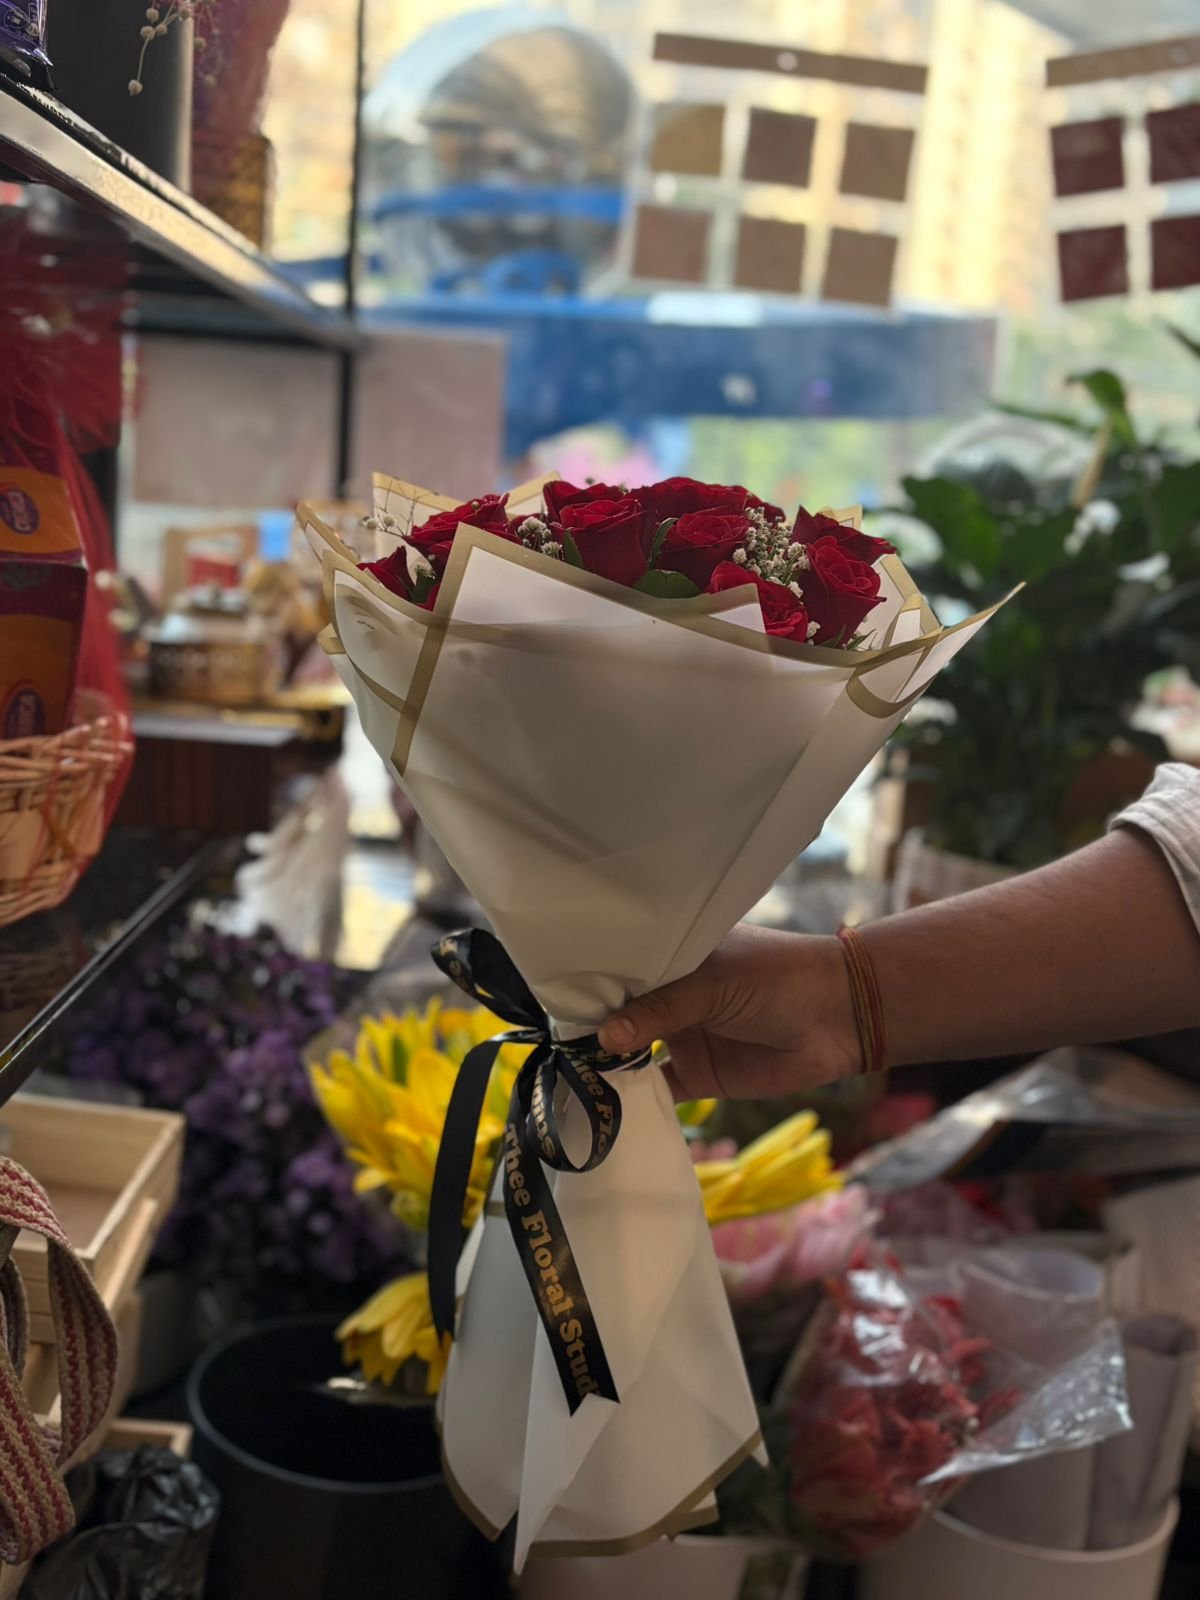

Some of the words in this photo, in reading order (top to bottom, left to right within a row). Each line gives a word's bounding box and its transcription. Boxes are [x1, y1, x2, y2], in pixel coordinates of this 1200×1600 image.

[504, 1123, 532, 1208] Thee
[521, 1209, 575, 1317] Floral
[559, 1317, 599, 1398] Stud
